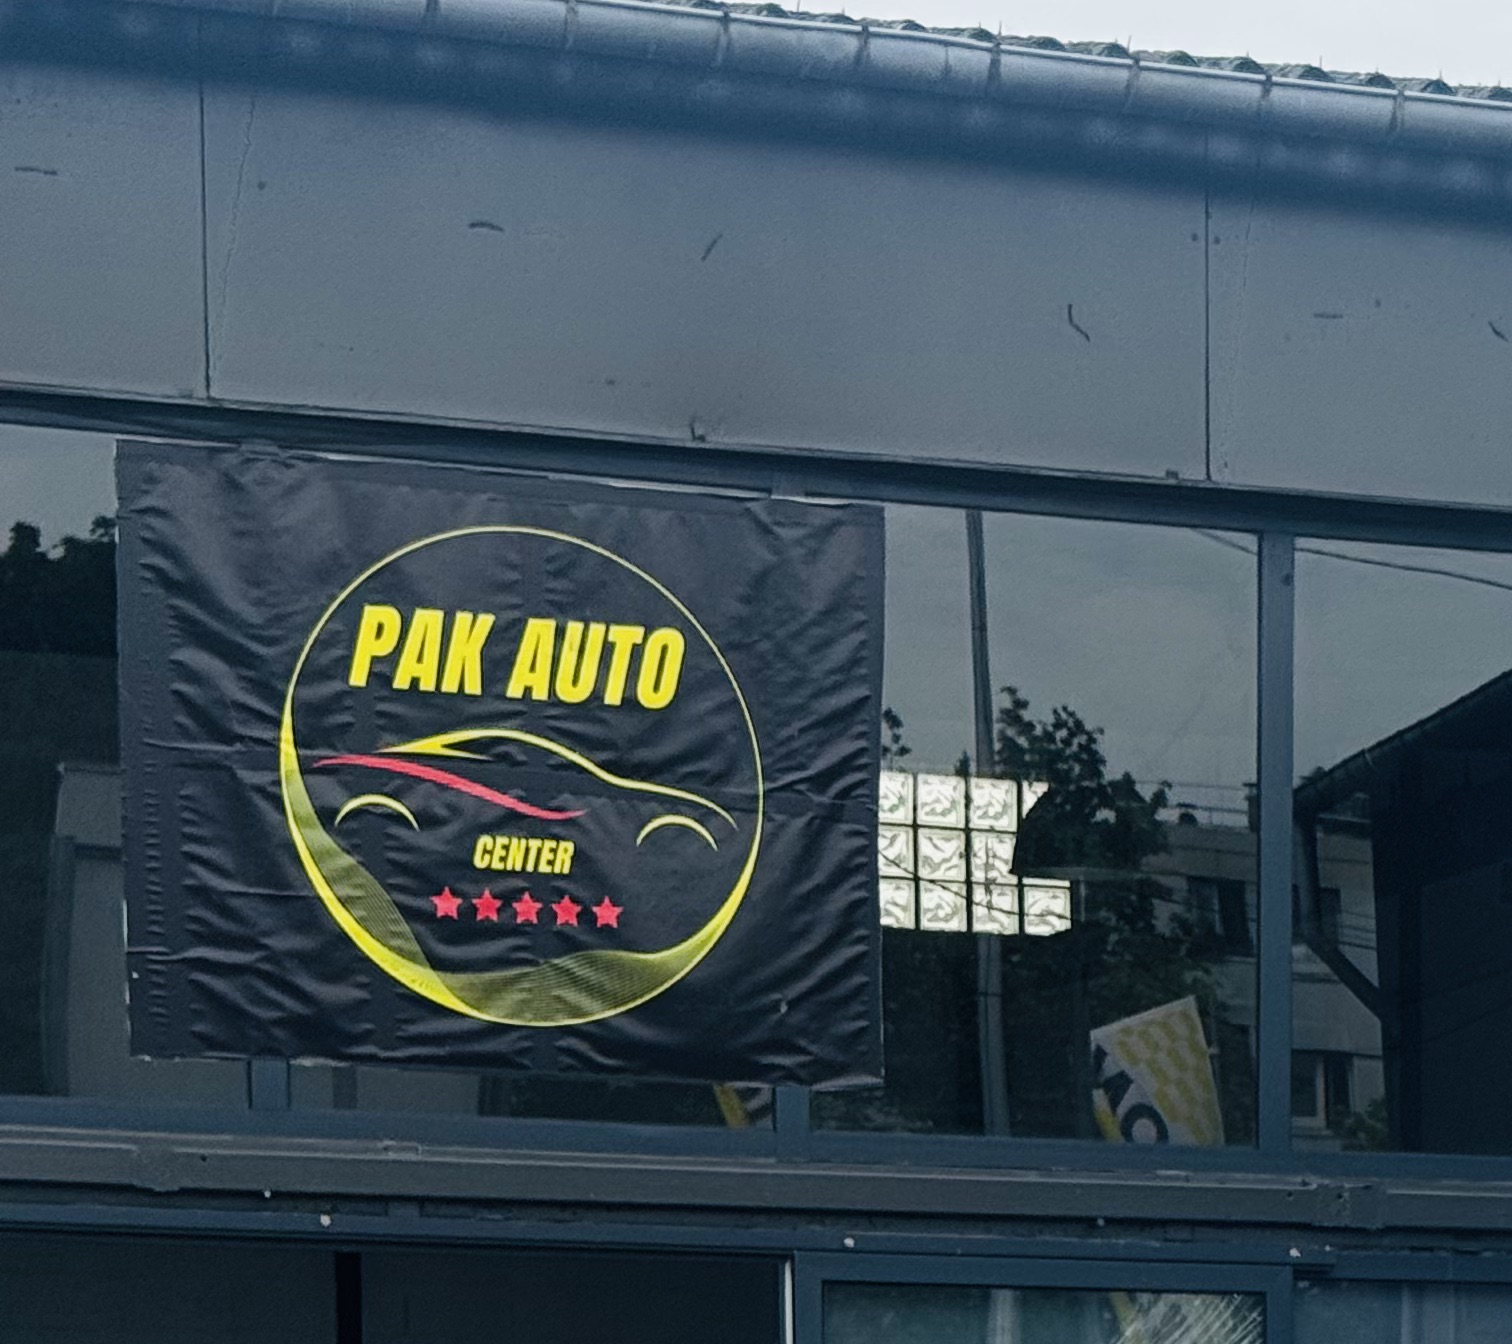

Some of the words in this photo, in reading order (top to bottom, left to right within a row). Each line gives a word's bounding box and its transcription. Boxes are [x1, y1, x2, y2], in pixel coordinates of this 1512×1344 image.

[348, 603, 497, 697] PAK
[506, 617, 687, 710] AUTO
[473, 833, 575, 876] CENTER
